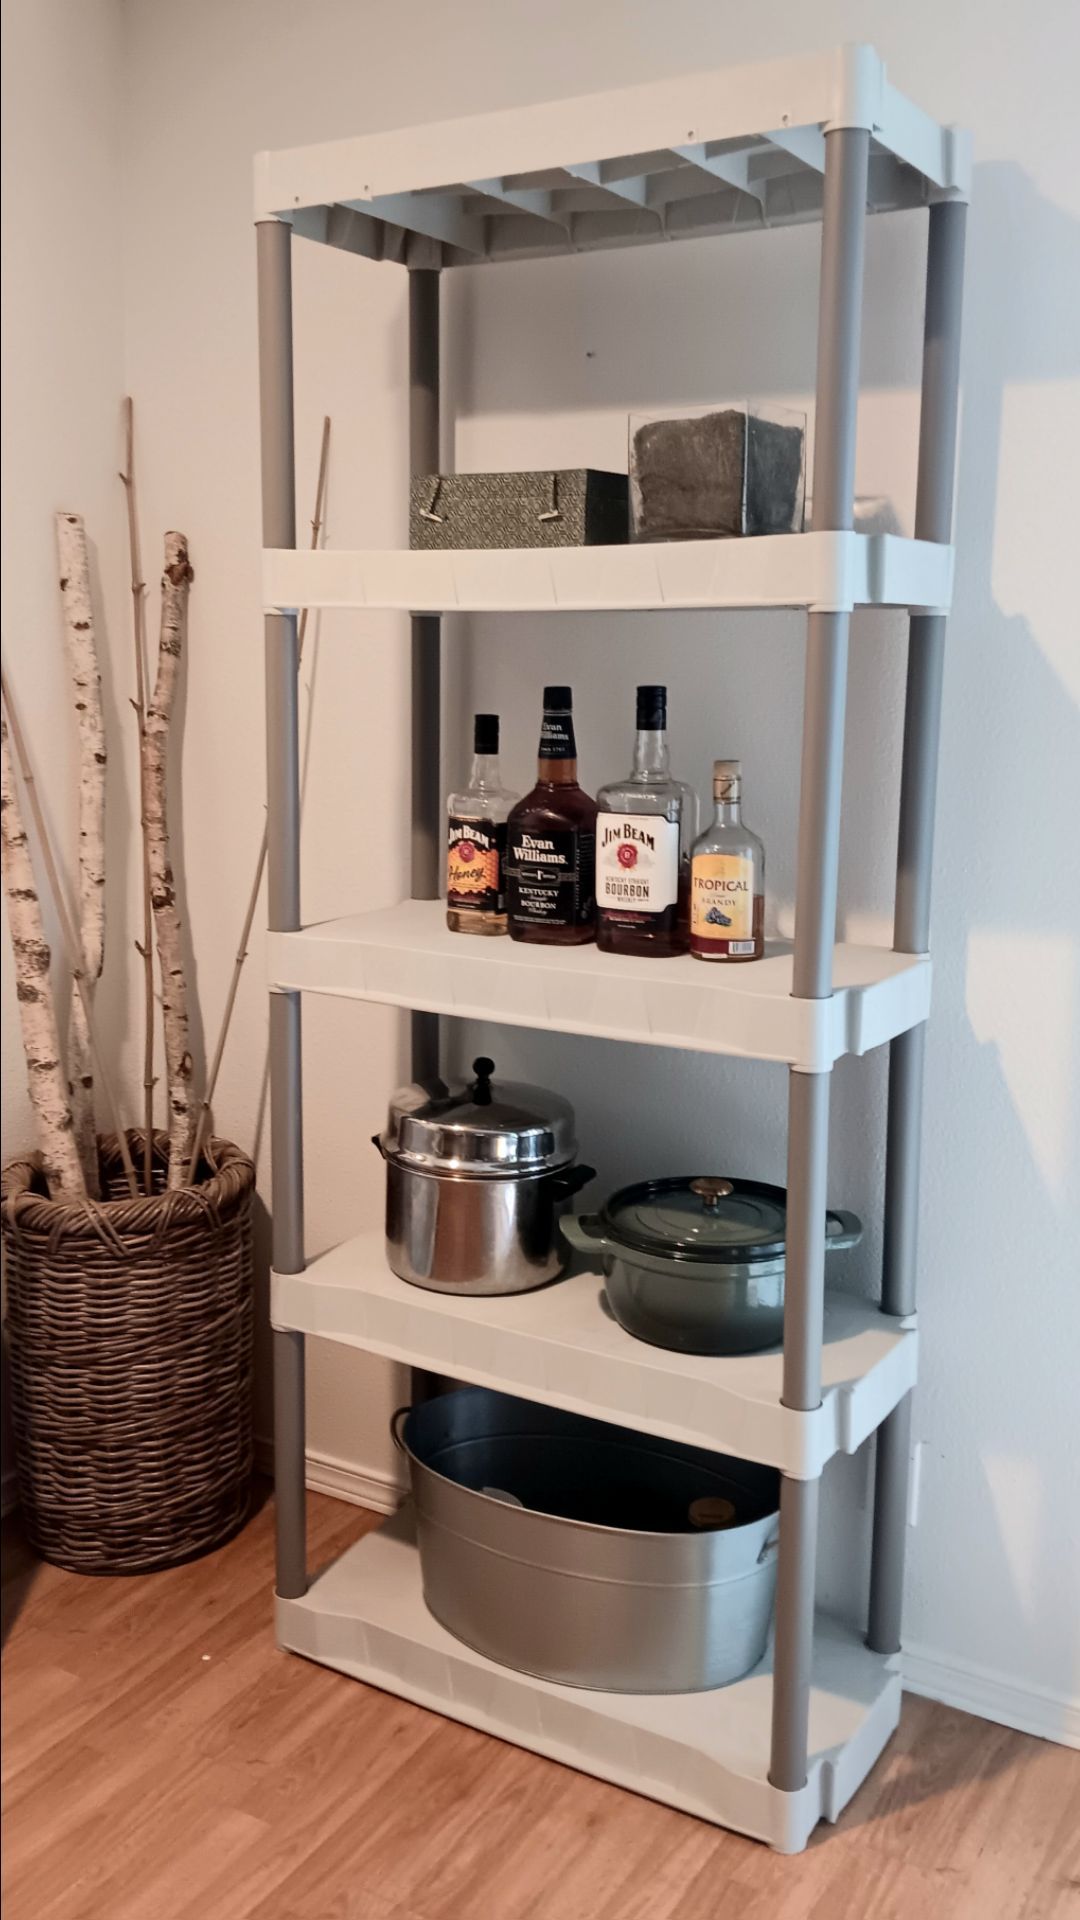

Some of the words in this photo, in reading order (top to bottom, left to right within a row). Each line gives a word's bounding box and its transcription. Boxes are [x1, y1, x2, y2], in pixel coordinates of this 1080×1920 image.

[462, 824, 489, 850] BEAM
[521, 834, 555, 850] Evan
[601, 827, 621, 848] JIM
[623, 823, 655, 852] BEAM
[513, 847, 567, 865] Williams
[448, 865, 487, 882] Honey
[518, 886, 560, 897] KENTUCKY
[605, 882, 650, 898] BOURBON
[693, 876, 749, 892] TROPICAL
[520, 899, 557, 910] BOURBON
